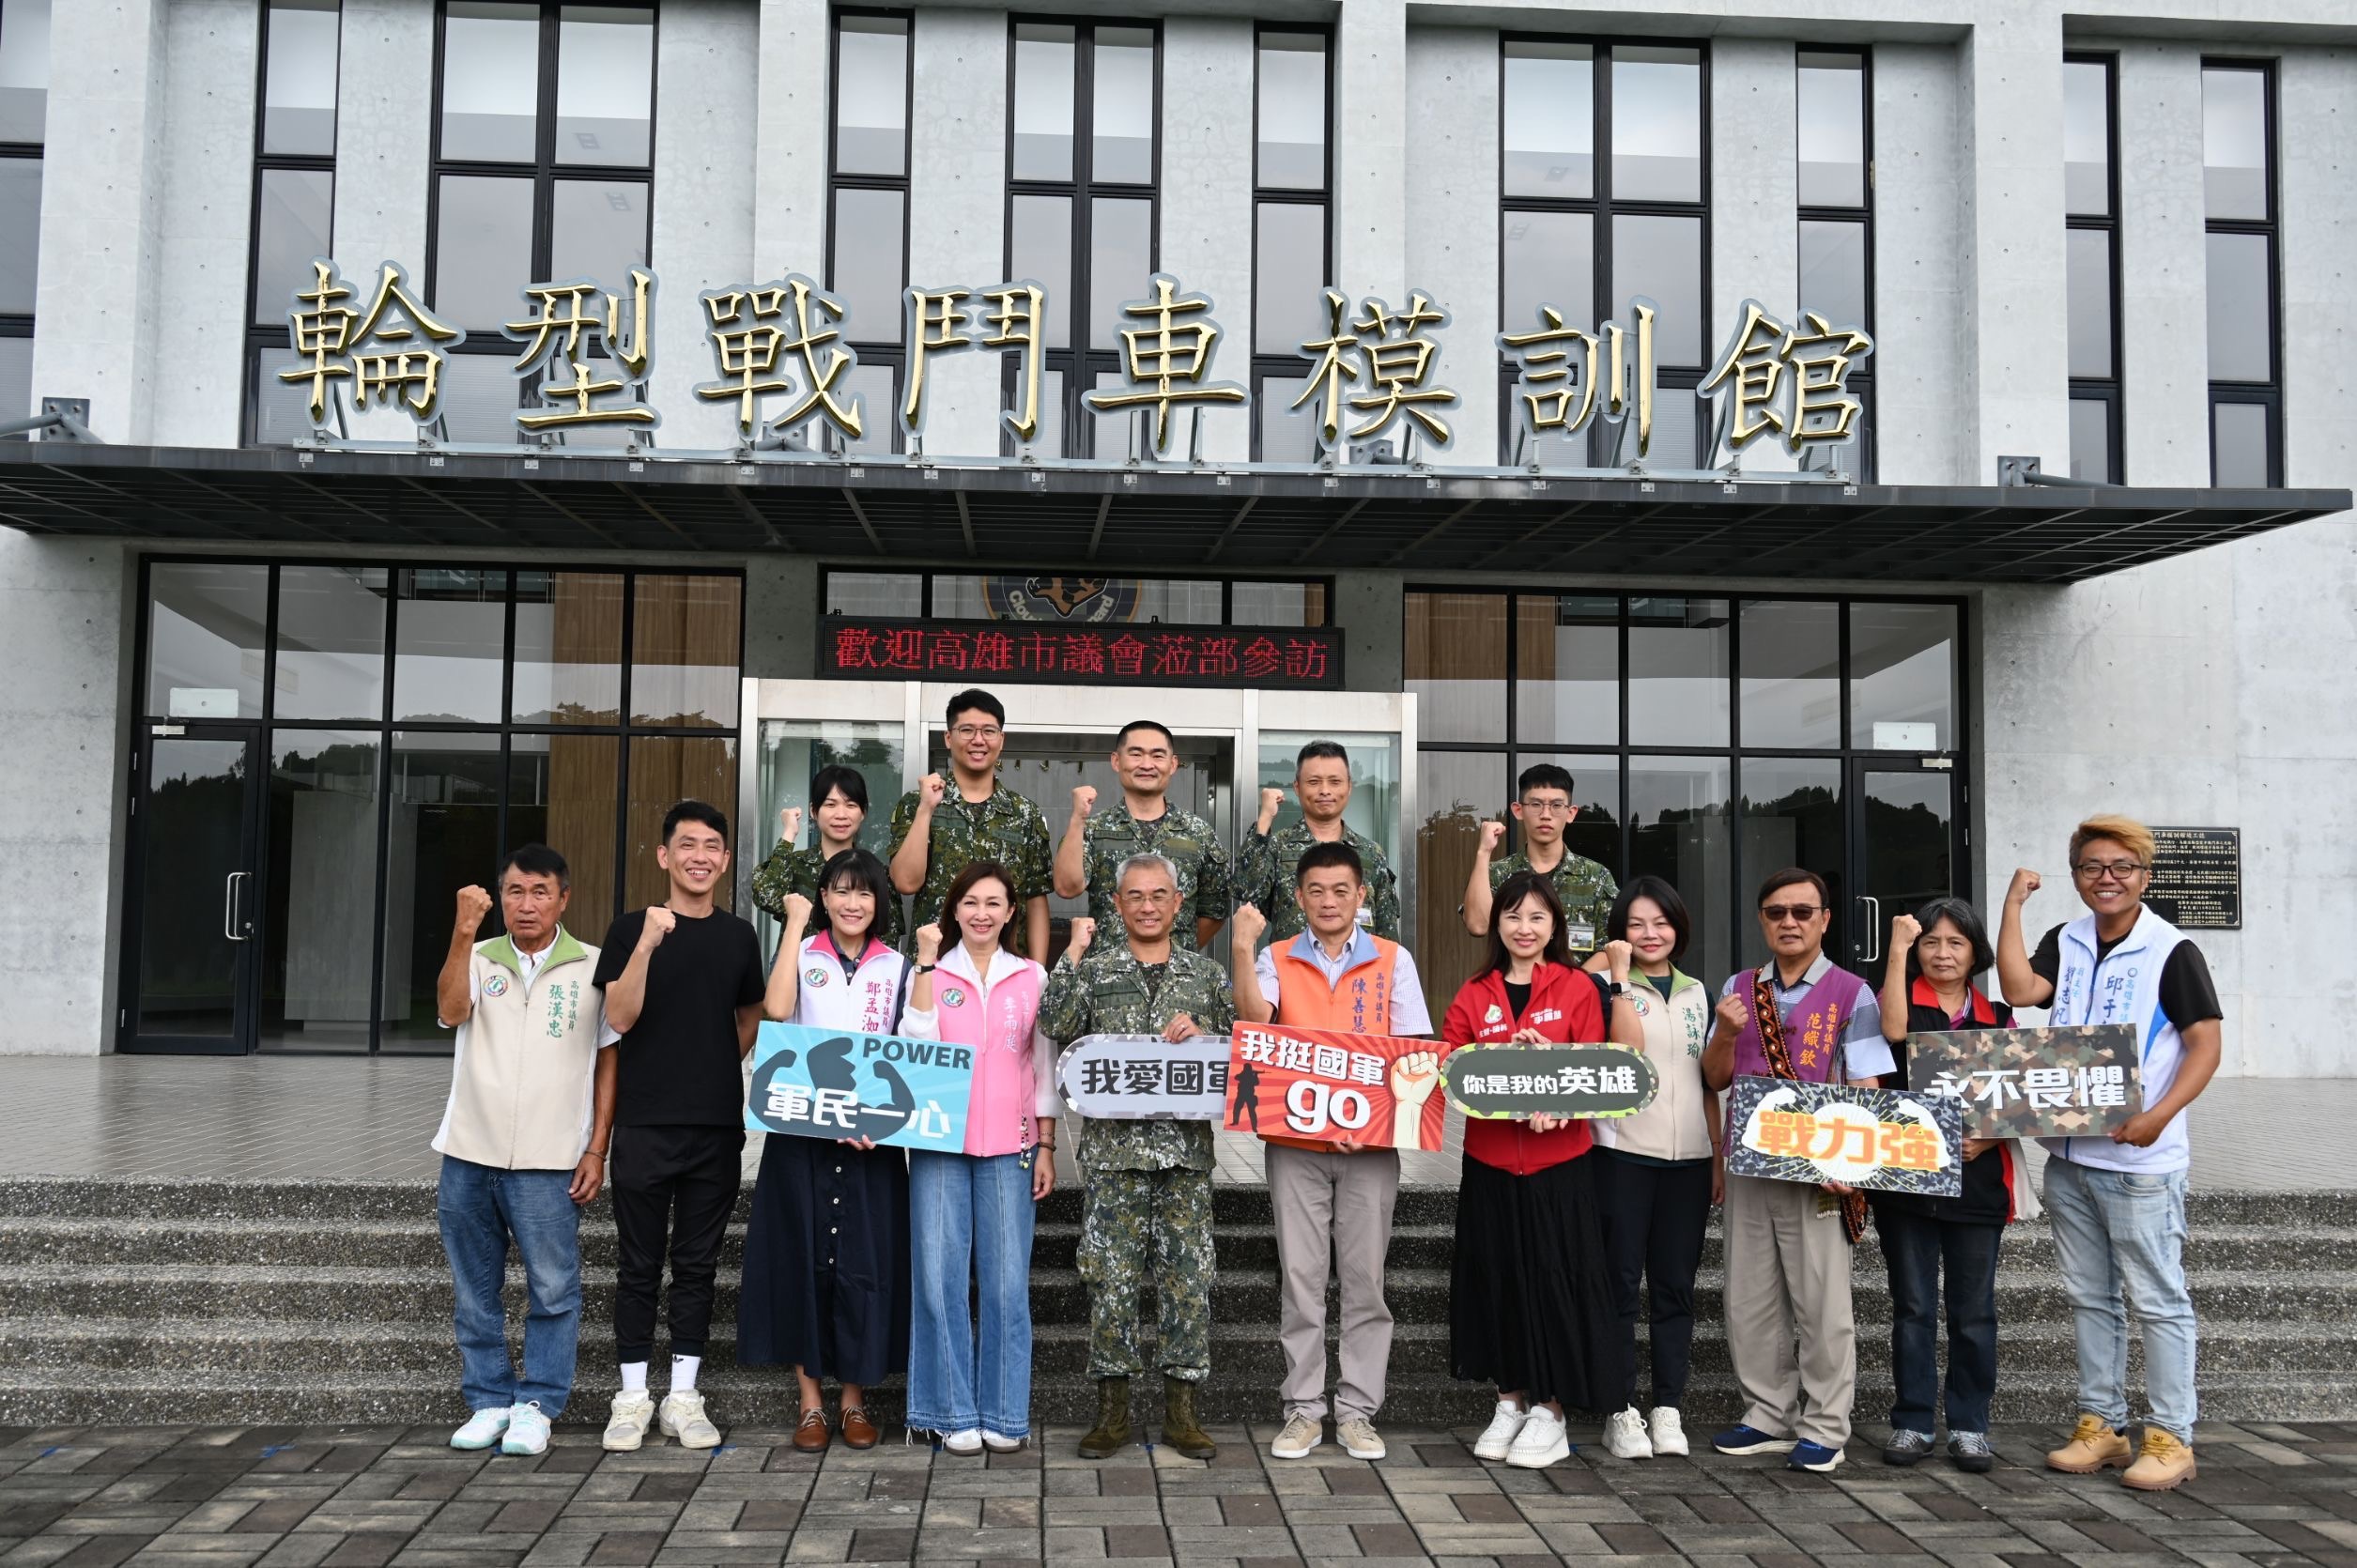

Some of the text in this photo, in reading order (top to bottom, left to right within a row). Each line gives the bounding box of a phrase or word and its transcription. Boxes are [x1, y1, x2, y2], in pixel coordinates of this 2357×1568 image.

[278, 259, 1871, 458] 輪型戰鬥車模訓館
[1009, 590, 1043, 621] Clou
[835, 627, 1329, 680] 歡迎高雄市議會蒞部參訪
[547, 984, 565, 1038] 張漢忠
[862, 1038, 971, 1069] POWER
[1240, 1029, 1386, 1087] 我挺國軍
[1462, 1066, 1639, 1095] 你是我的英雄
[763, 1082, 952, 1139] 軍民一心
[1286, 1080, 1371, 1134] go
[1924, 1065, 2127, 1110] 永不畏懼
[1756, 1110, 1941, 1173] 戰力強
